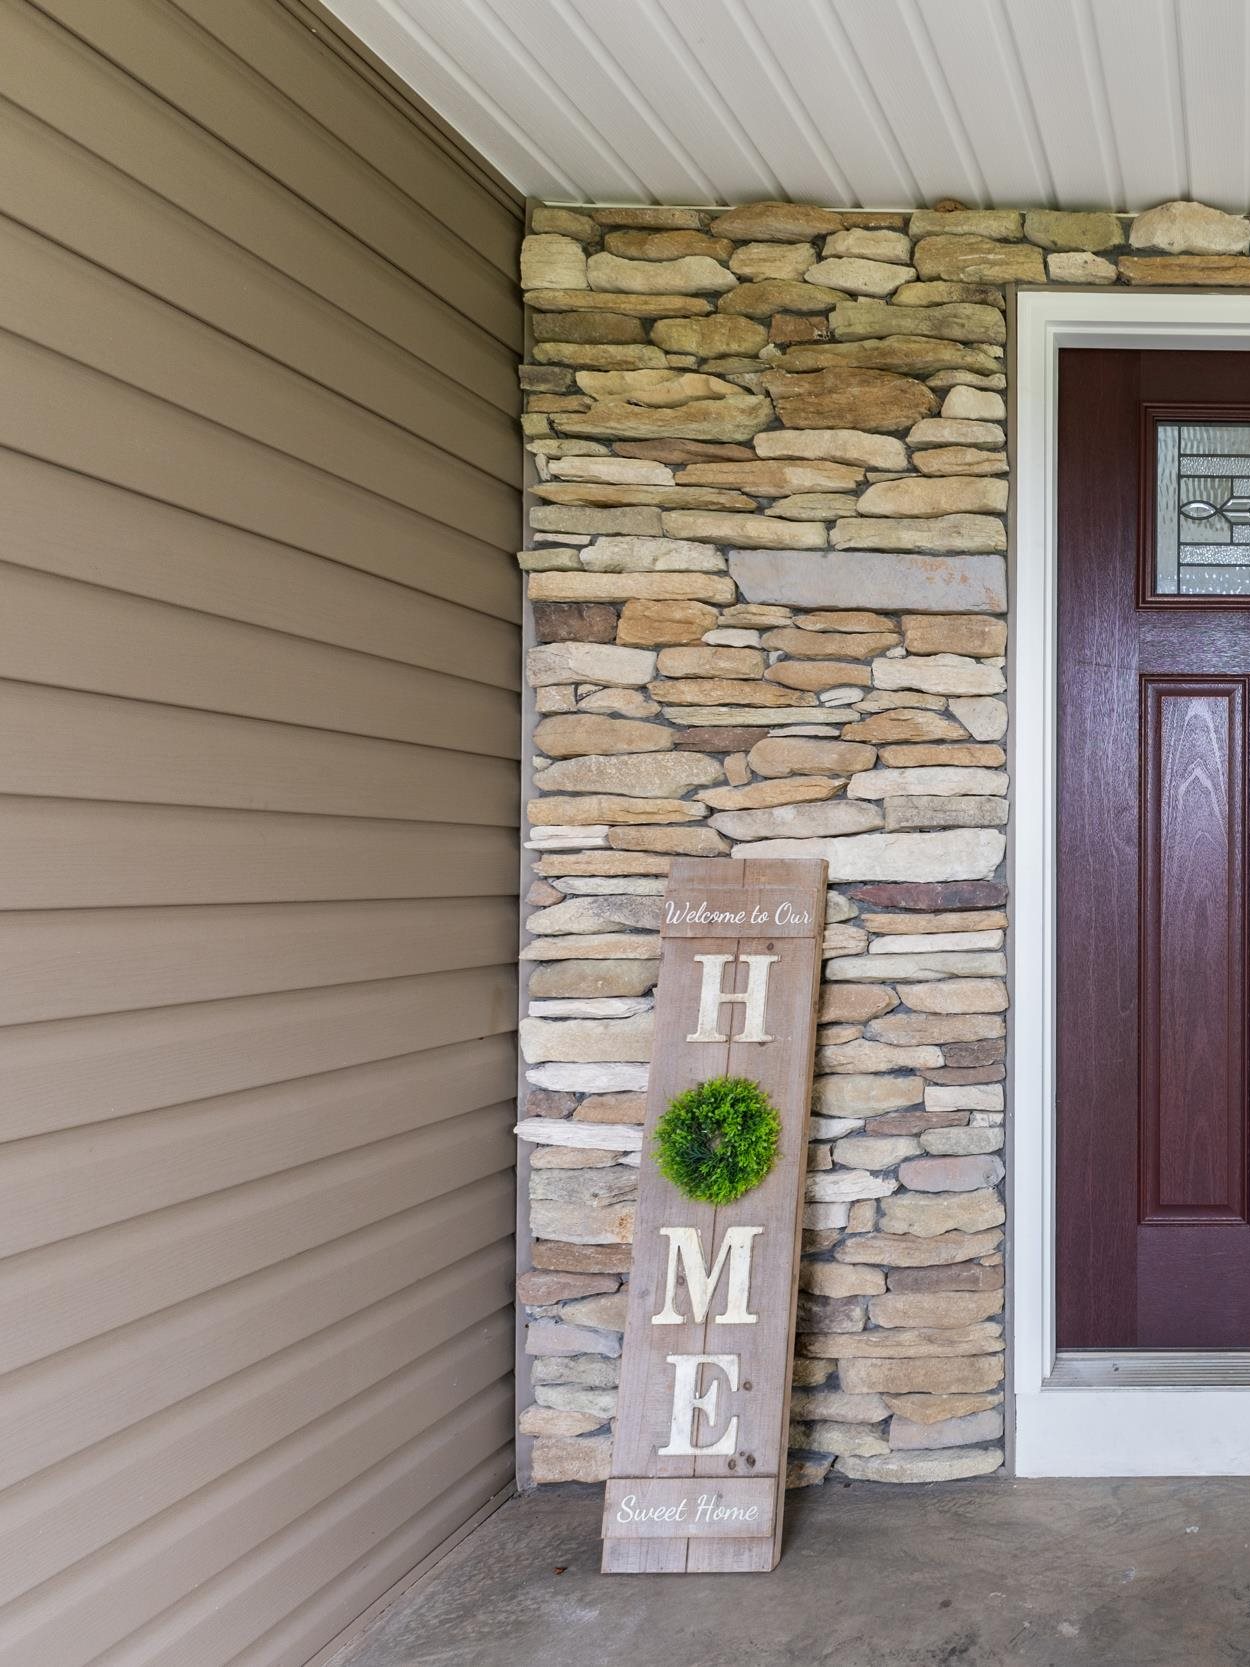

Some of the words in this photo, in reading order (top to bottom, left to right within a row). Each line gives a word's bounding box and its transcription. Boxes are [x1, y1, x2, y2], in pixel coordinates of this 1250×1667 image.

[664, 900, 746, 925] Welcome
[750, 904, 769, 924] to
[774, 900, 812, 925] Our
[616, 1494, 688, 1523] Sweet
[694, 1493, 759, 1522] Home
